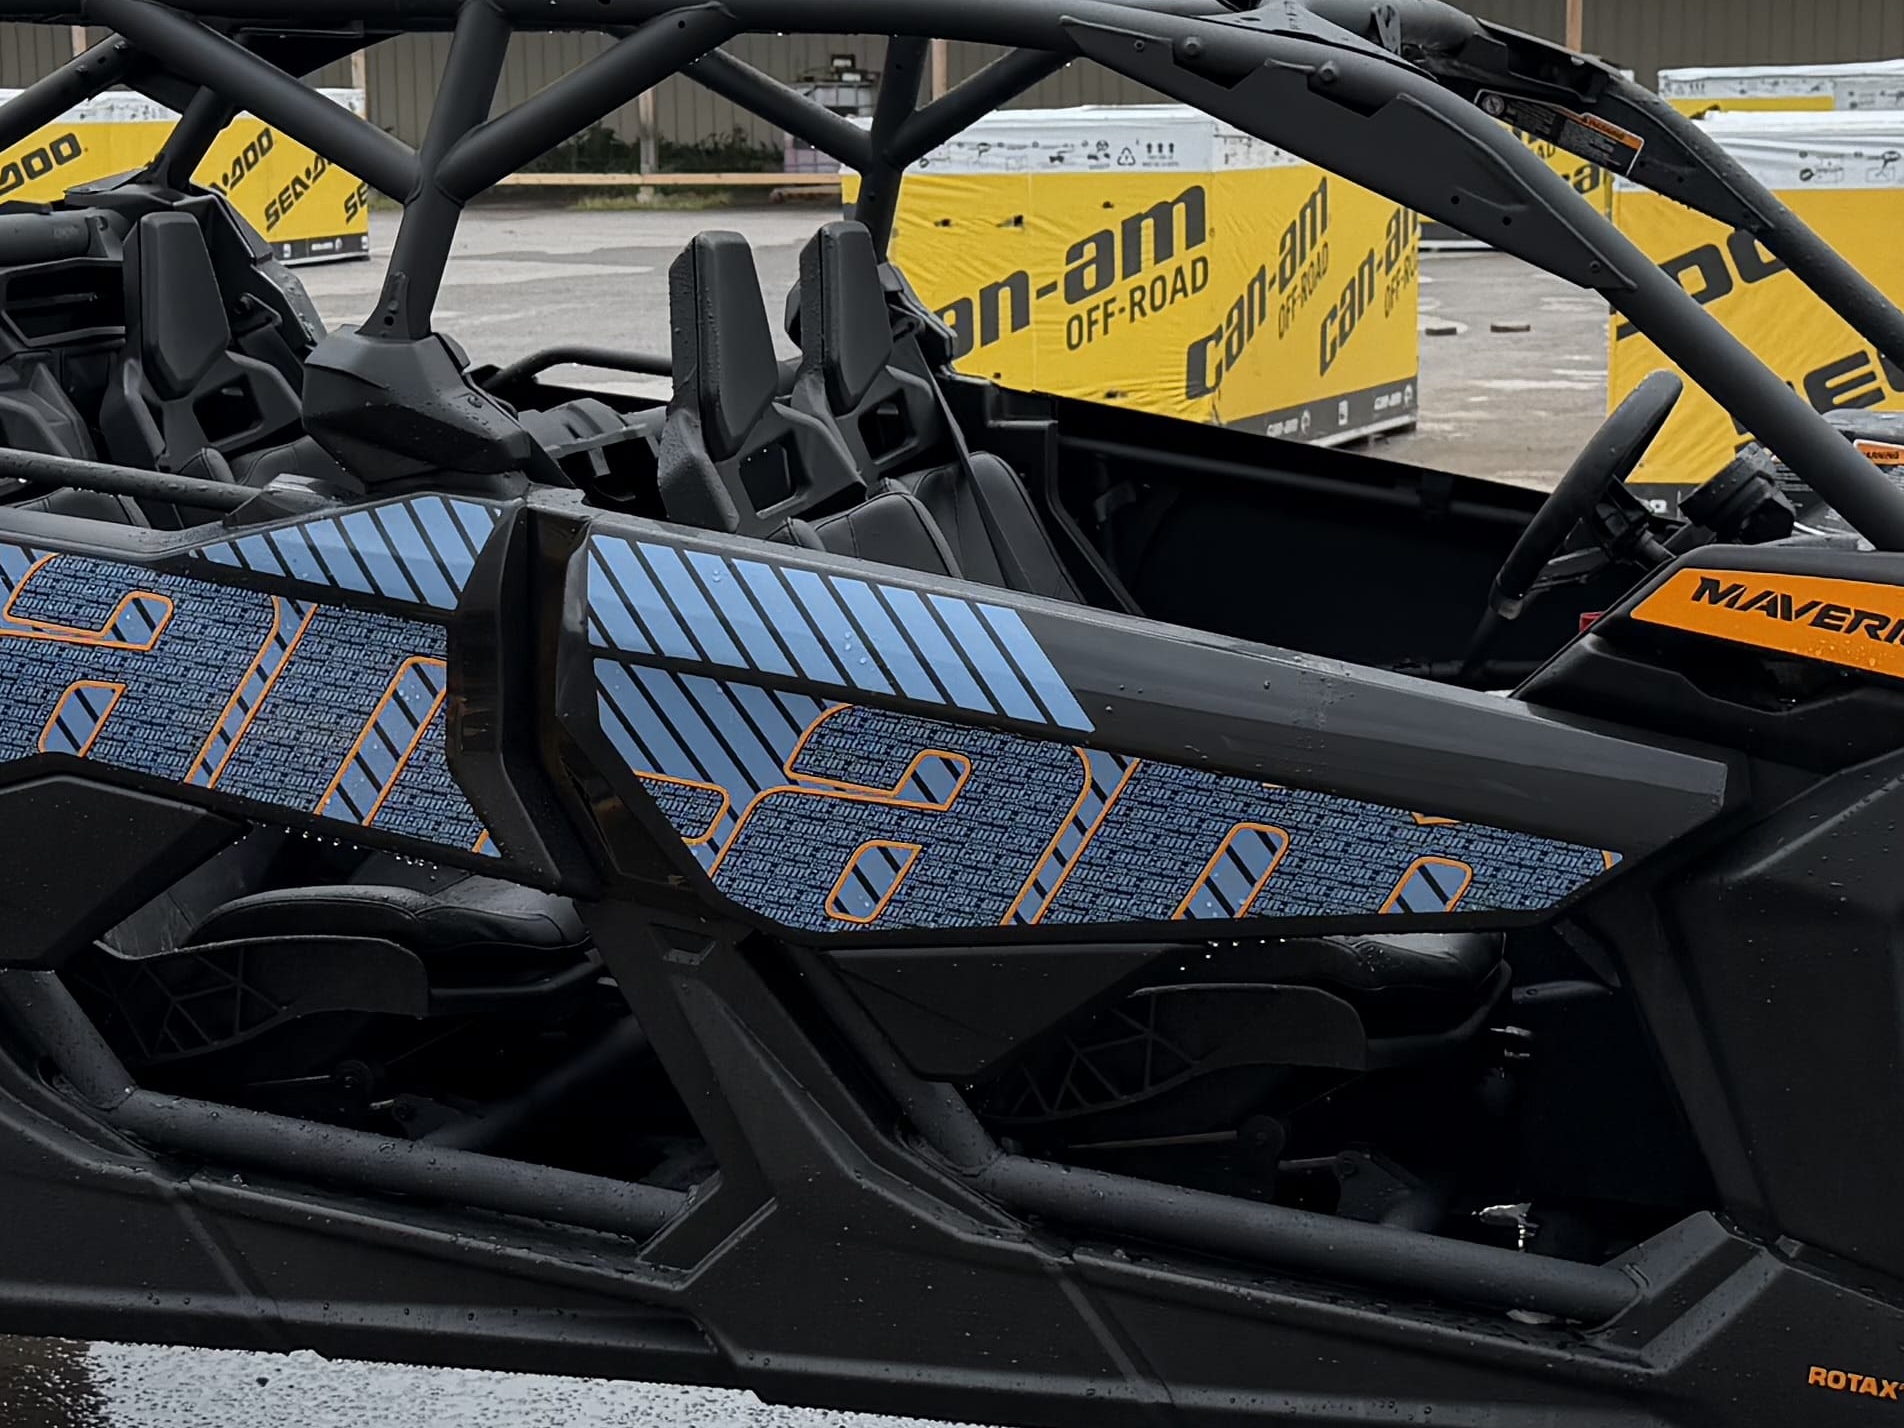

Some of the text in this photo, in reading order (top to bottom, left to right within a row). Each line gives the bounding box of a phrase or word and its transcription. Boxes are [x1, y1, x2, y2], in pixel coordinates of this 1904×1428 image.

[1066, 255, 1209, 352] OFF-ROAD
[1185, 175, 1329, 401] can-am
[1278, 241, 1330, 341] OFF-ROAD
[1807, 1365, 1900, 1401] ROTAX
